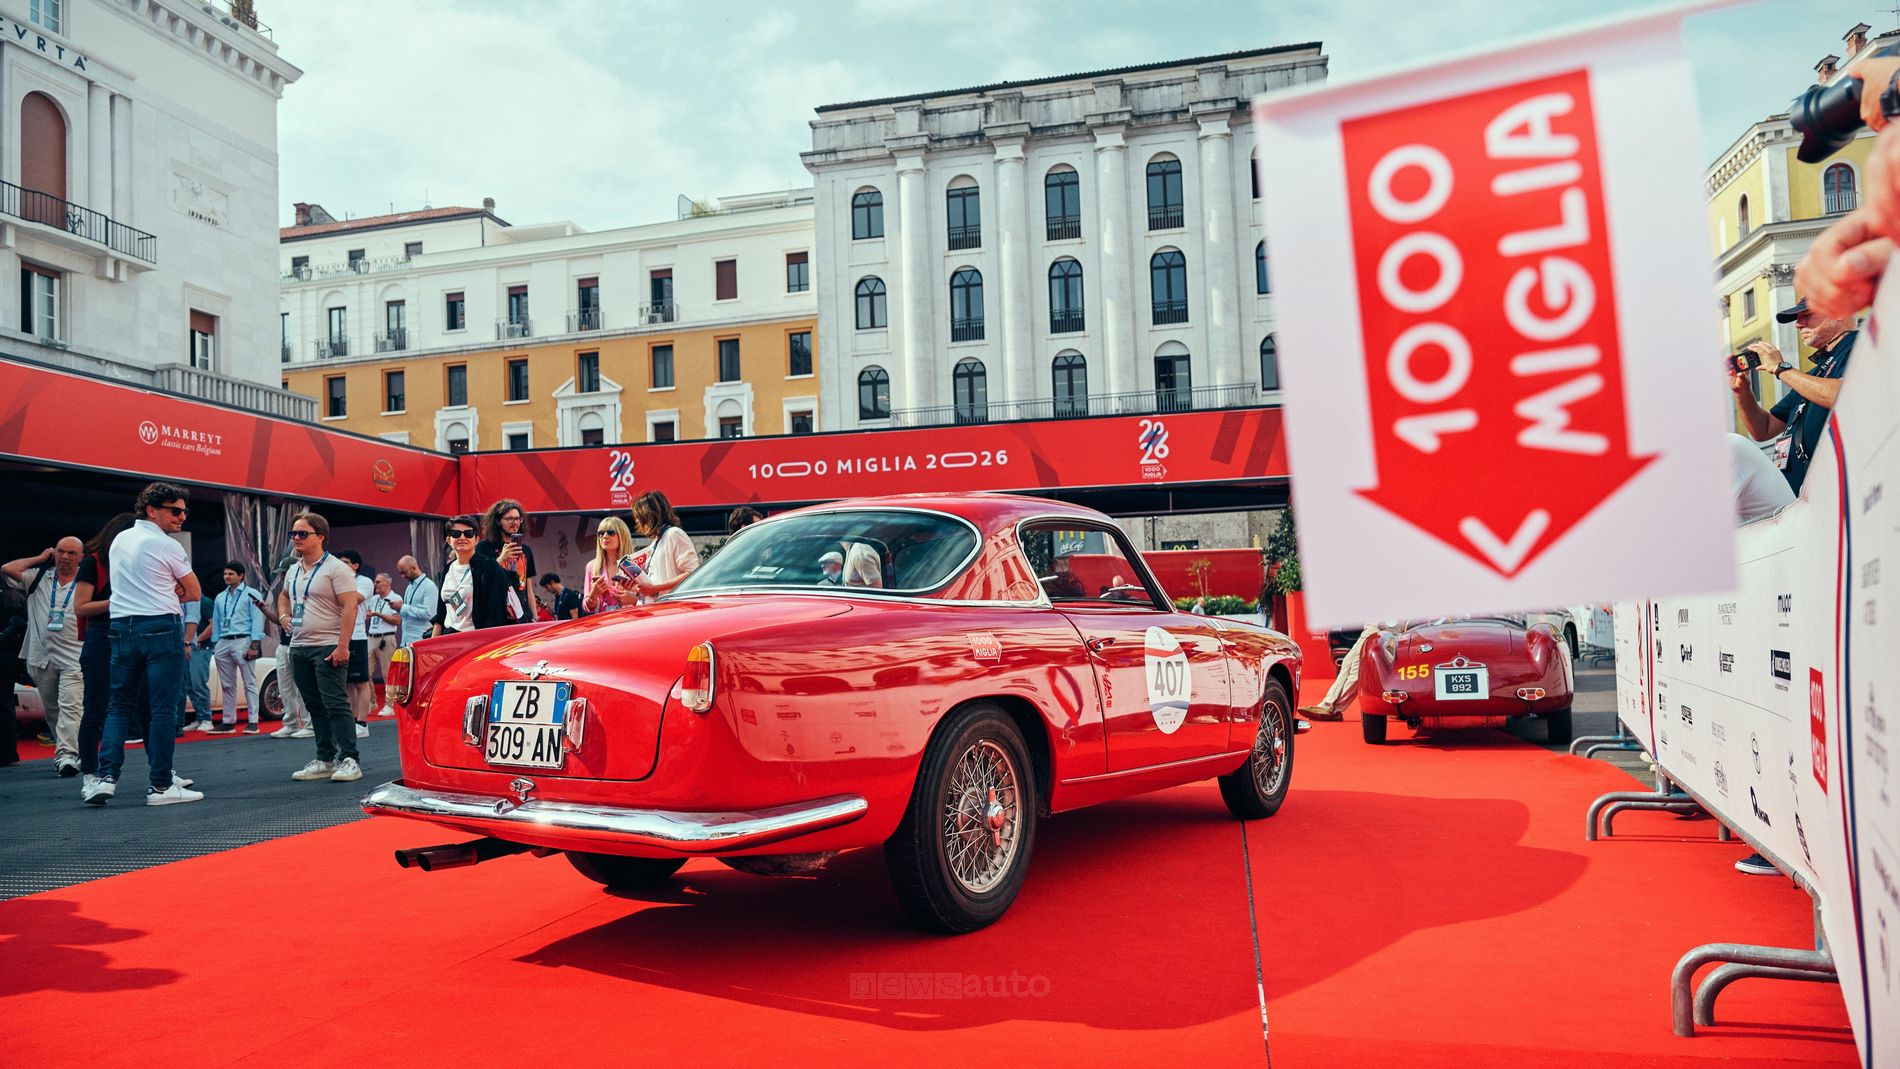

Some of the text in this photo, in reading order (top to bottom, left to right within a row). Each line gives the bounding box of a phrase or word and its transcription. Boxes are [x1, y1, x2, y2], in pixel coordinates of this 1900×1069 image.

[1485, 93, 1610, 455] MIGLIA
[1368, 144, 1478, 454] 1000
[161, 425, 222, 445] MARREYT
[161, 438, 222, 456] classic cars Belgium
[748, 449, 1009, 479] 1000 MIGLIA 2026
[972, 637, 993, 645] 1000
[975, 647, 999, 657] MIGLIA
[1154, 660, 1184, 698] 407
[1398, 664, 1430, 681] 155
[1451, 674, 1472, 683] KXS
[1451, 683, 1472, 692] 892
[512, 685, 541, 719] ZB
[487, 725, 562, 763] 309 AN
